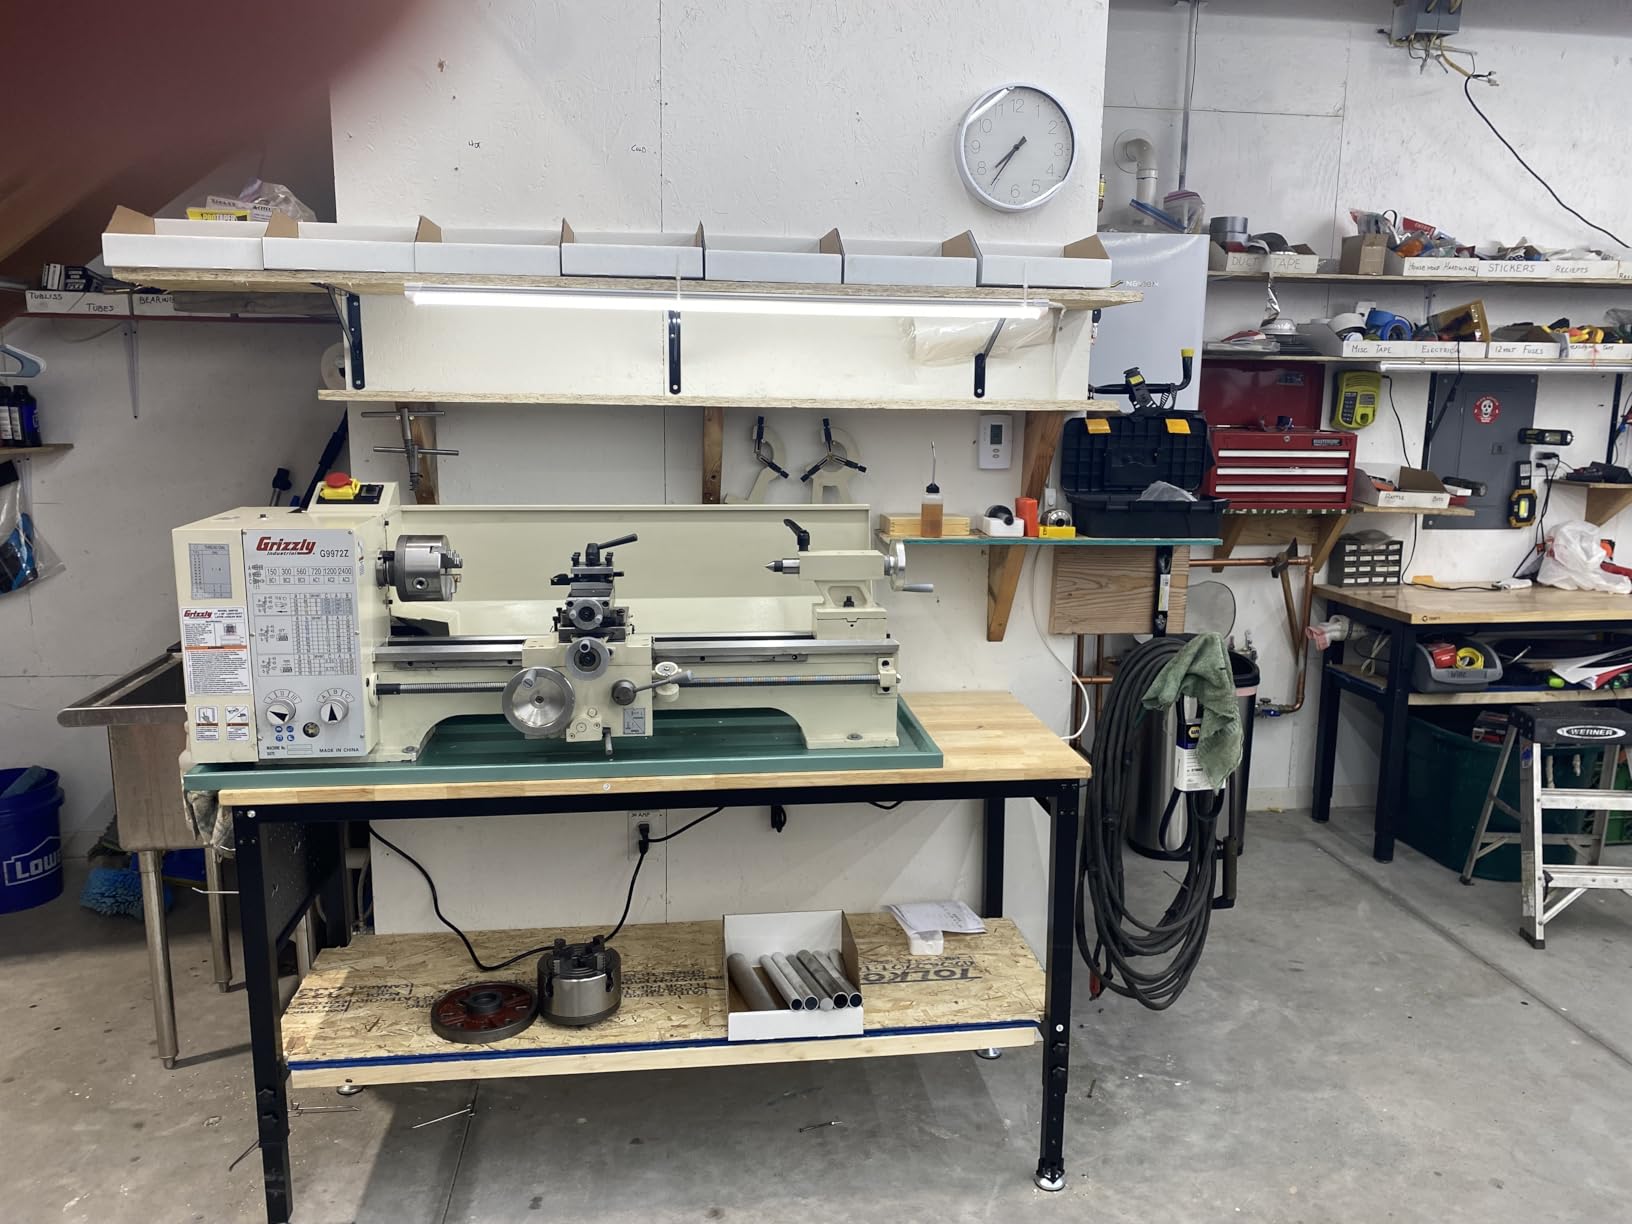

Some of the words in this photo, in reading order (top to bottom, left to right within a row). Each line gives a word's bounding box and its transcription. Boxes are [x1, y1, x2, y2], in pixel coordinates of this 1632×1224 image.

[994, 104, 1004, 117] 11
[1012, 99, 1024, 113] 12
[979, 119, 992, 133] 10
[1048, 120, 1057, 135] 2
[971, 140, 980, 154] 9
[1054, 142, 1064, 157] 3
[977, 161, 987, 175] 8
[1046, 163, 1055, 176] 4
[1011, 184, 1020, 198] 6
[1031, 179, 1040, 193] 5
[1272, 257, 1302, 269] TAPE
[1488, 263, 1536, 273] STICKERS
[86, 303, 114, 312] TUBES
[1376, 344, 1392, 354] TAPE
[1523, 344, 1544, 354] FUSES
[256, 536, 317, 556] Grizzly
[319, 549, 350, 558] G9972Z
[266, 568, 277, 576] 150
[281, 568, 292, 576] 300
[311, 568, 322, 576] 720
[324, 567, 337, 575] 1200
[337, 567, 352, 575] 2400
[184, 610, 212, 618] Grizzly
[1571, 728, 1613, 736] WERNER
